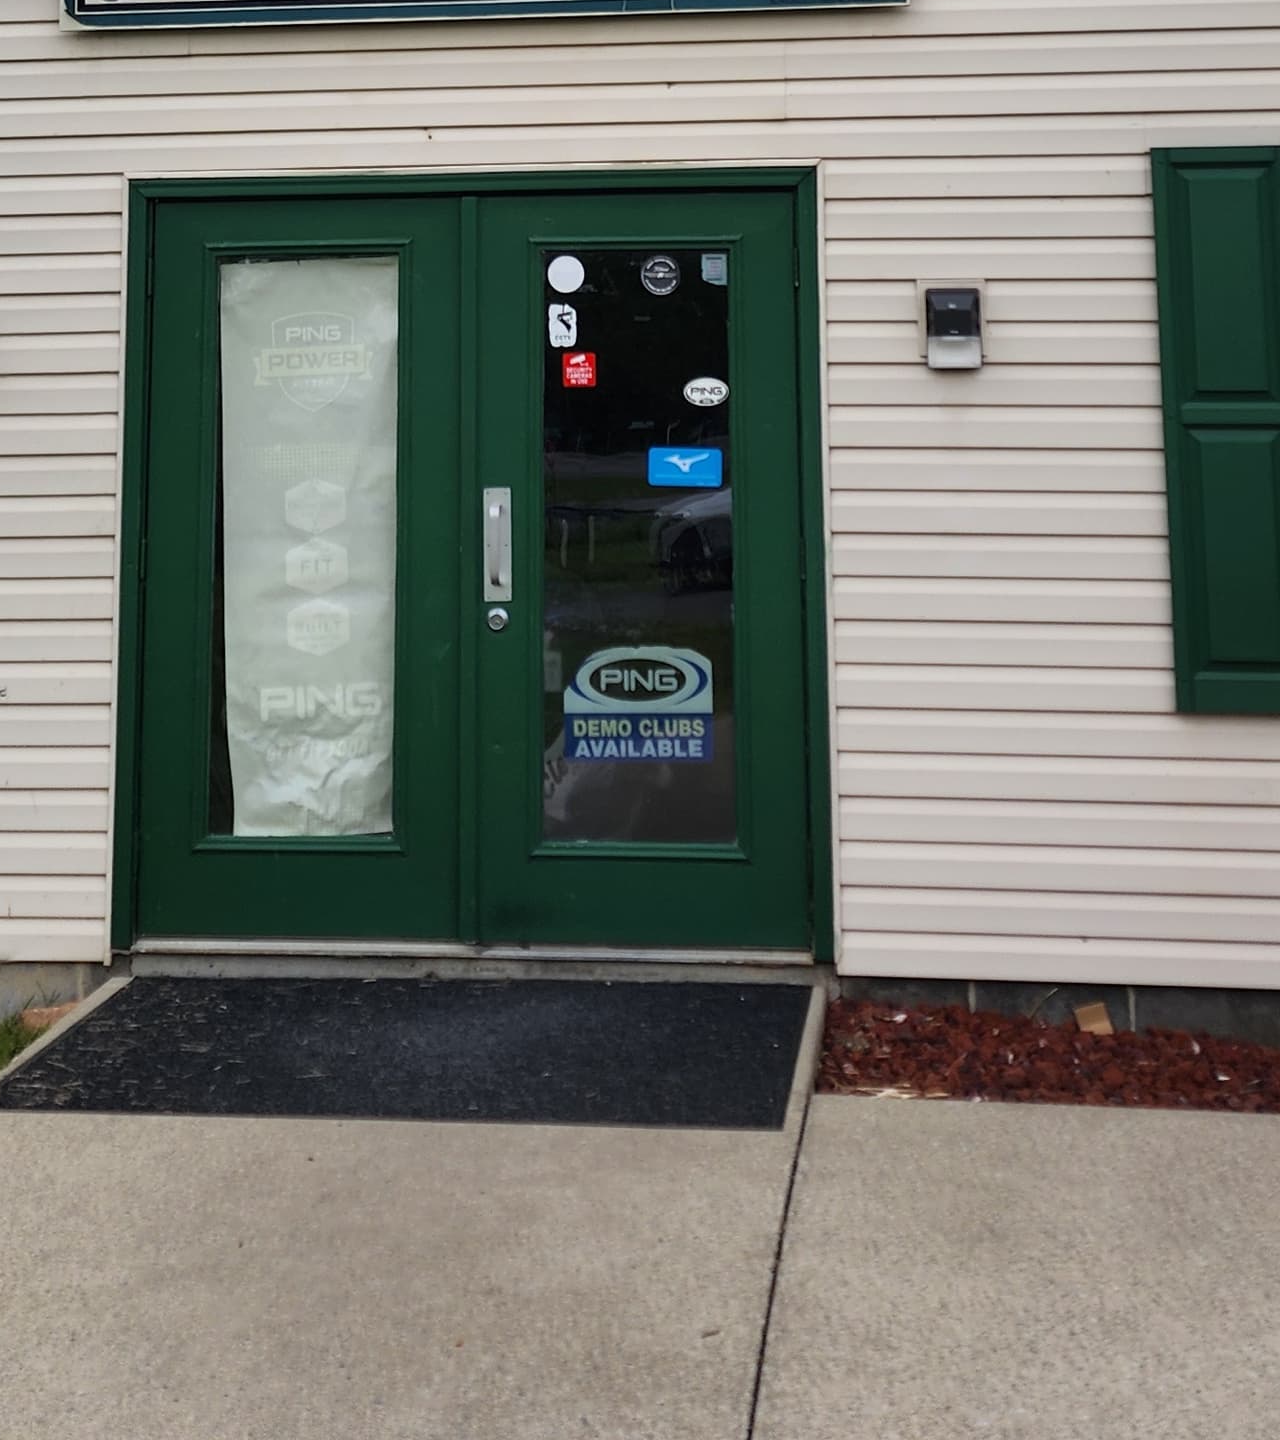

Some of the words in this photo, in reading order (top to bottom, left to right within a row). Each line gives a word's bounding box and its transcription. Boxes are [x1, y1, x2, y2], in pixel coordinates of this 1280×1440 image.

[285, 324, 342, 343] PING
[268, 349, 360, 371] POWER
[690, 386, 723, 397] PING
[599, 668, 679, 693] PING
[259, 681, 383, 722] PING
[573, 719, 632, 738] DEMO
[639, 719, 705, 738] CLUBS
[574, 739, 704, 759] AVAILABLE
